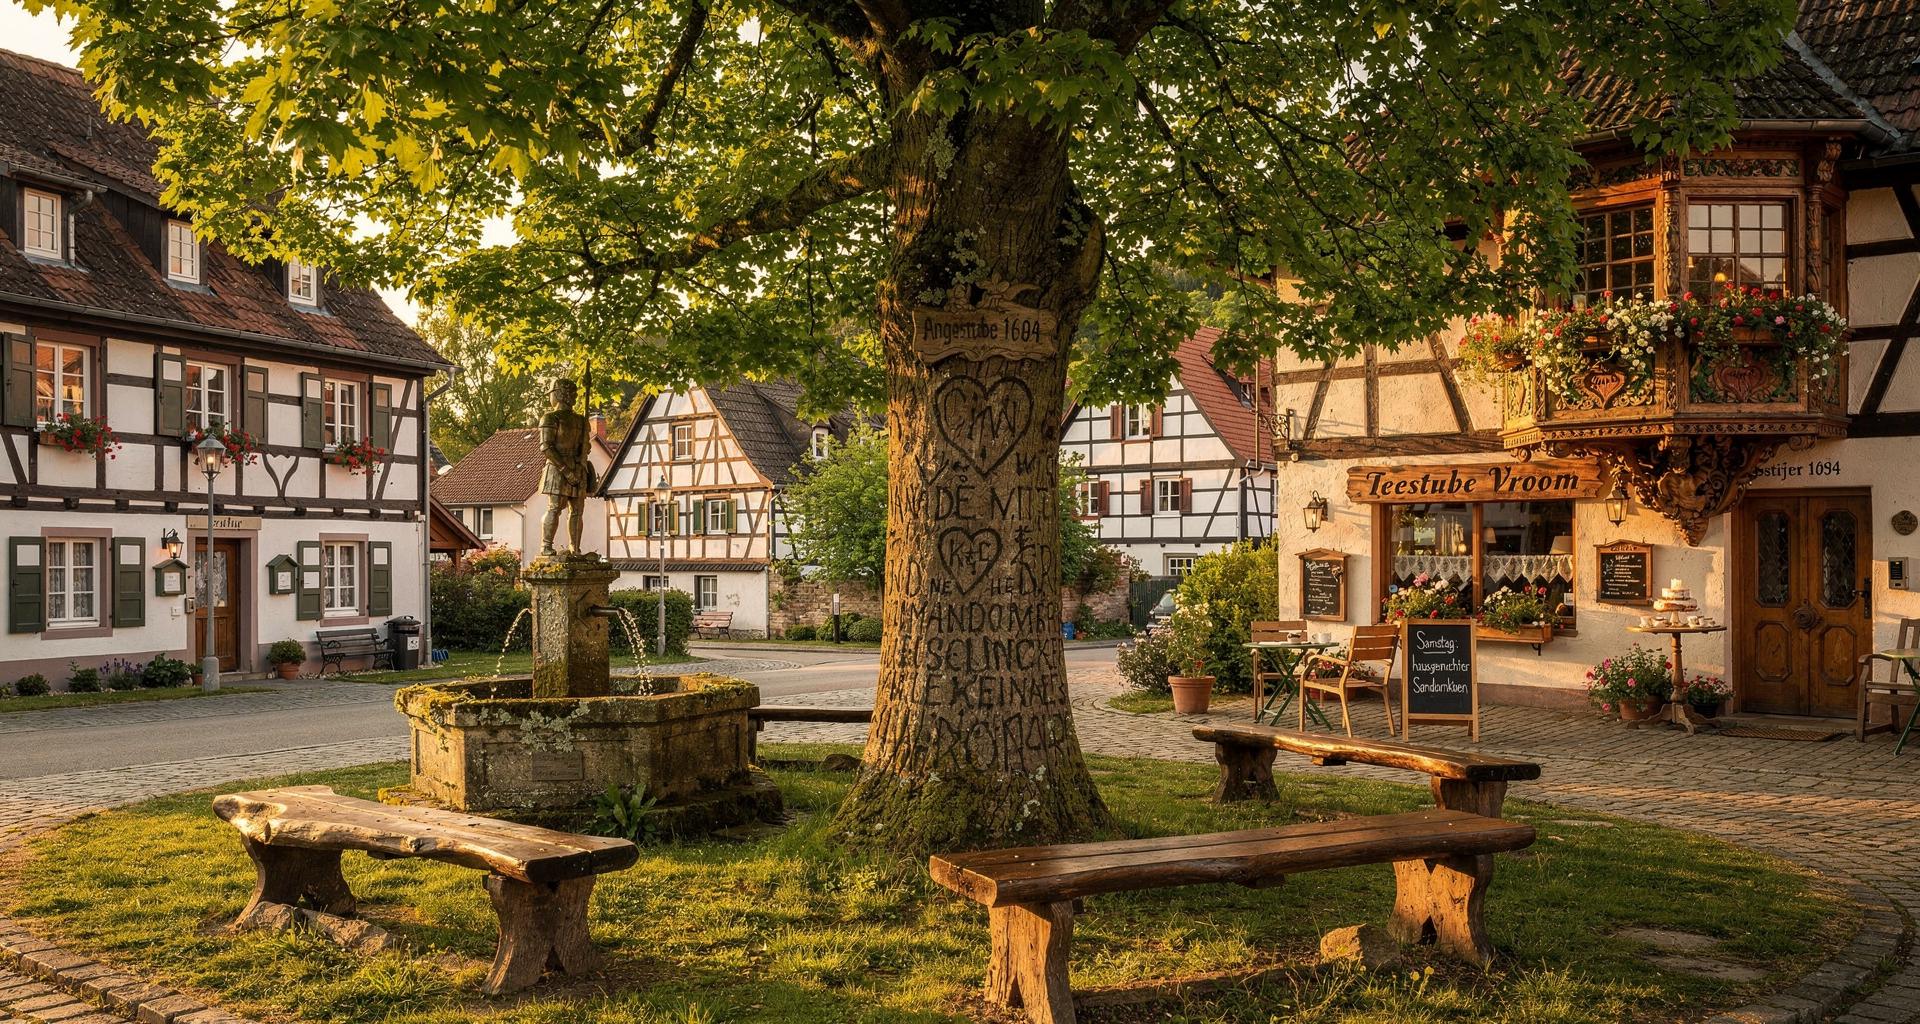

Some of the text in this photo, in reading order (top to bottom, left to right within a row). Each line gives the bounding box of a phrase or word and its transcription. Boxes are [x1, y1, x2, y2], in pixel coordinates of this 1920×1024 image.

[1366, 466, 1579, 499] Teestube Vroom
[1416, 630, 1459, 654] Samstag:
